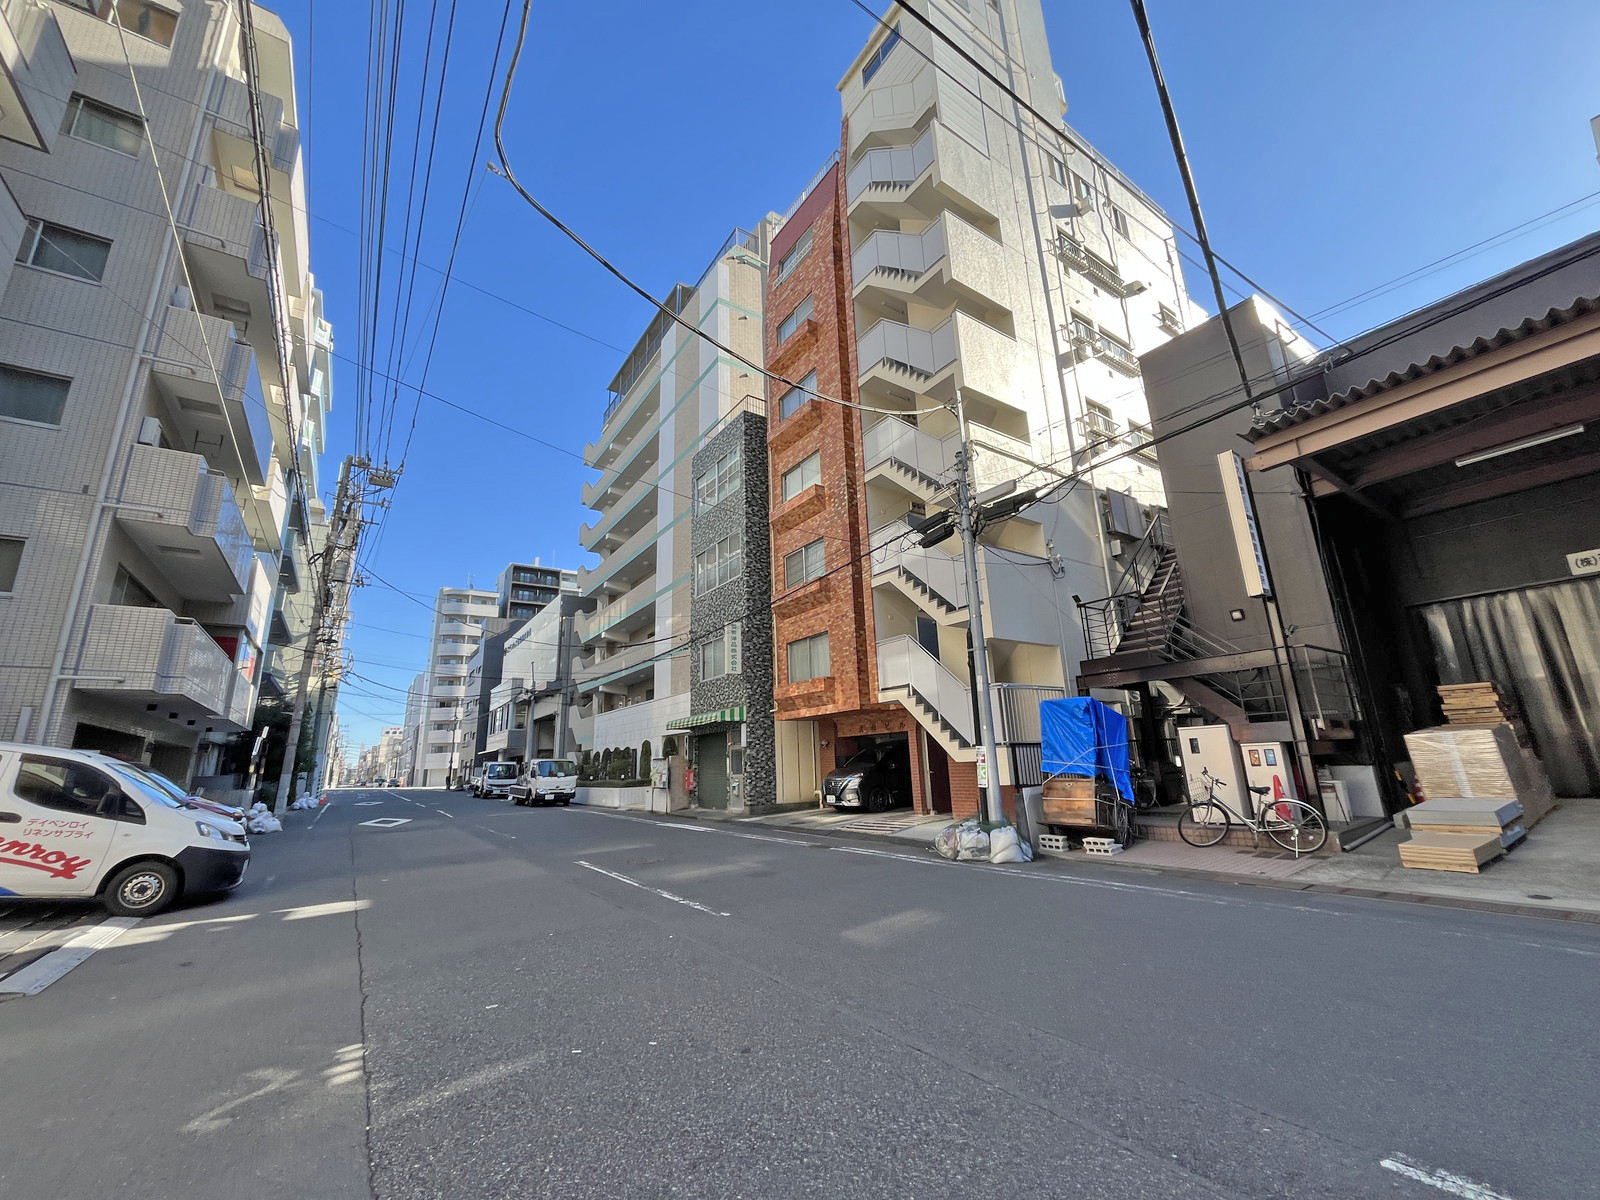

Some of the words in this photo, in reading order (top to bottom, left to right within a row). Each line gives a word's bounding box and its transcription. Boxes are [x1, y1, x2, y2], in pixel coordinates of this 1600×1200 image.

[1575, 553, 1600, 569] (株)
[23, 828, 94, 839] リネンサプライ
